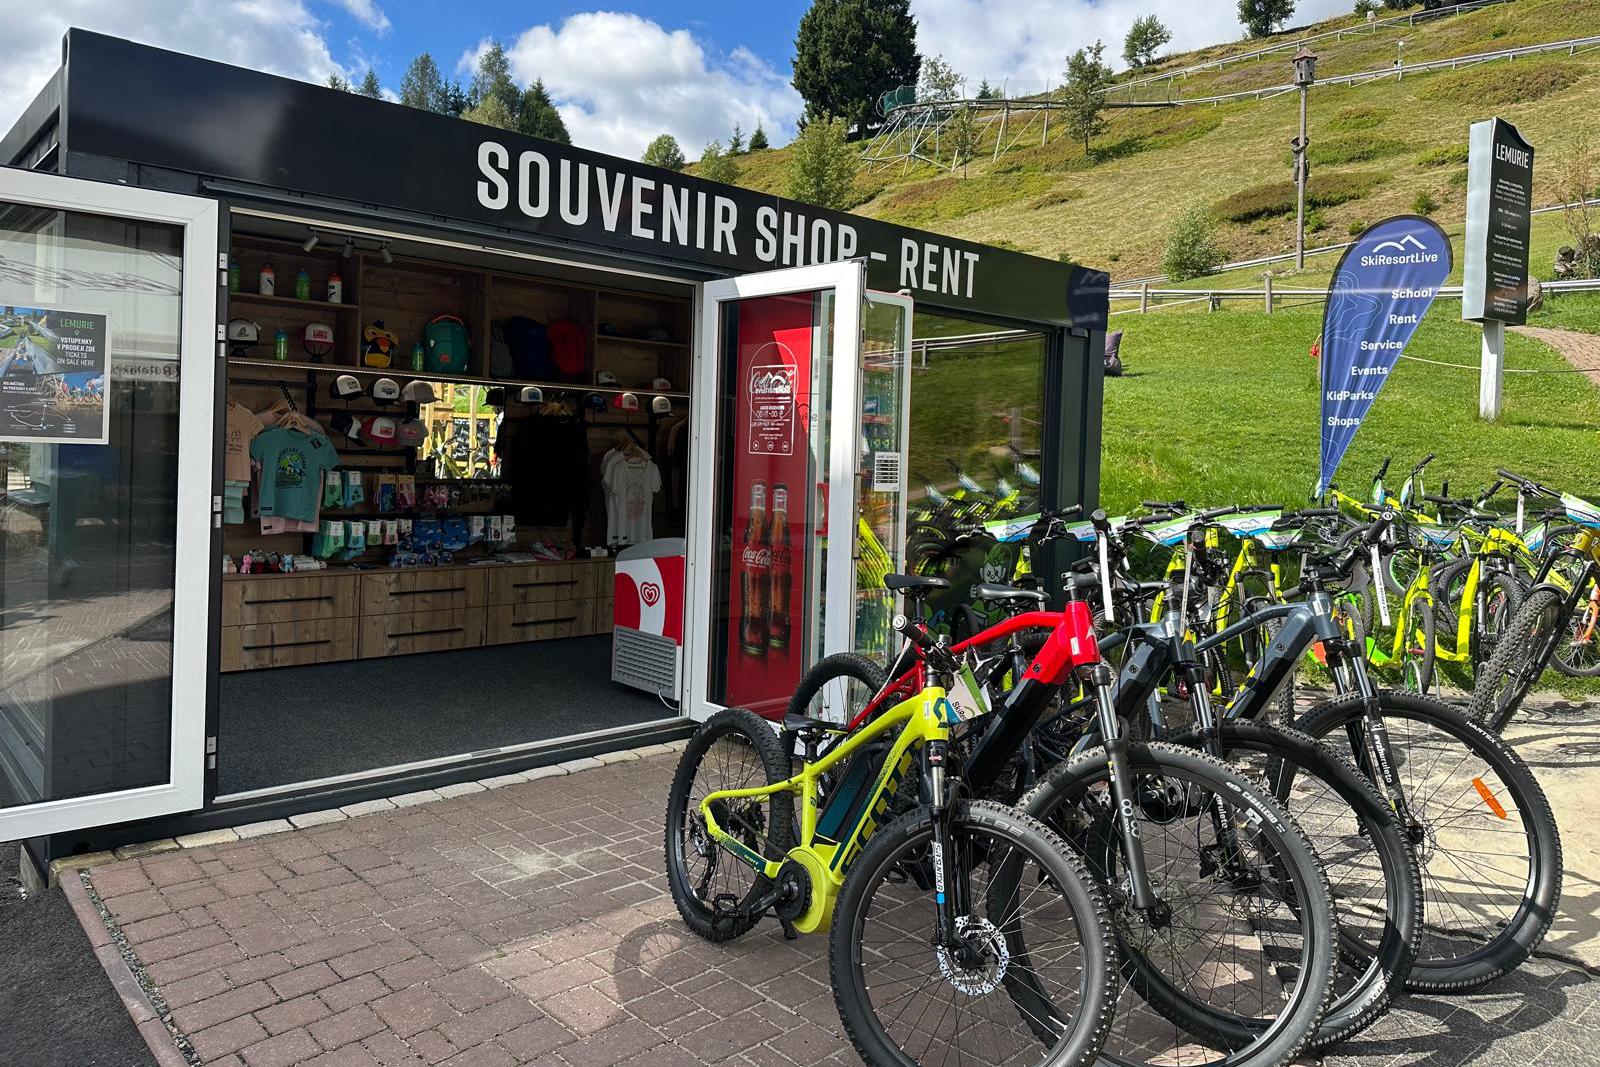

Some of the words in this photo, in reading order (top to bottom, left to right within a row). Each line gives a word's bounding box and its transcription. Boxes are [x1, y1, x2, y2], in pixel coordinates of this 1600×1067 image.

[1495, 143, 1529, 169] LEMURIE
[477, 141, 738, 256] SOUVENIR
[755, 206, 858, 268] SHOP
[900, 238, 980, 298] RENT
[1360, 251, 1438, 267] SkiResortLive
[1391, 287, 1433, 299] School
[60, 318, 95, 330] LEMURIE
[1389, 313, 1418, 325] Rent
[60, 336, 93, 346] VSTUPENKY
[1360, 340, 1404, 351] Service
[56, 343, 61, 351] V
[61, 343, 84, 353] PRODEJI
[84, 345, 96, 353] ZDE
[65, 351, 88, 359] TICKETS
[56, 357, 66, 365] ON
[66, 358, 80, 366] SALE
[80, 359, 95, 367] HERE
[1351, 365, 1389, 376] Events
[1326, 391, 1375, 402] KidParks
[1327, 416, 1360, 428] Shops
[1242, 790, 1278, 824] CABALLERO
